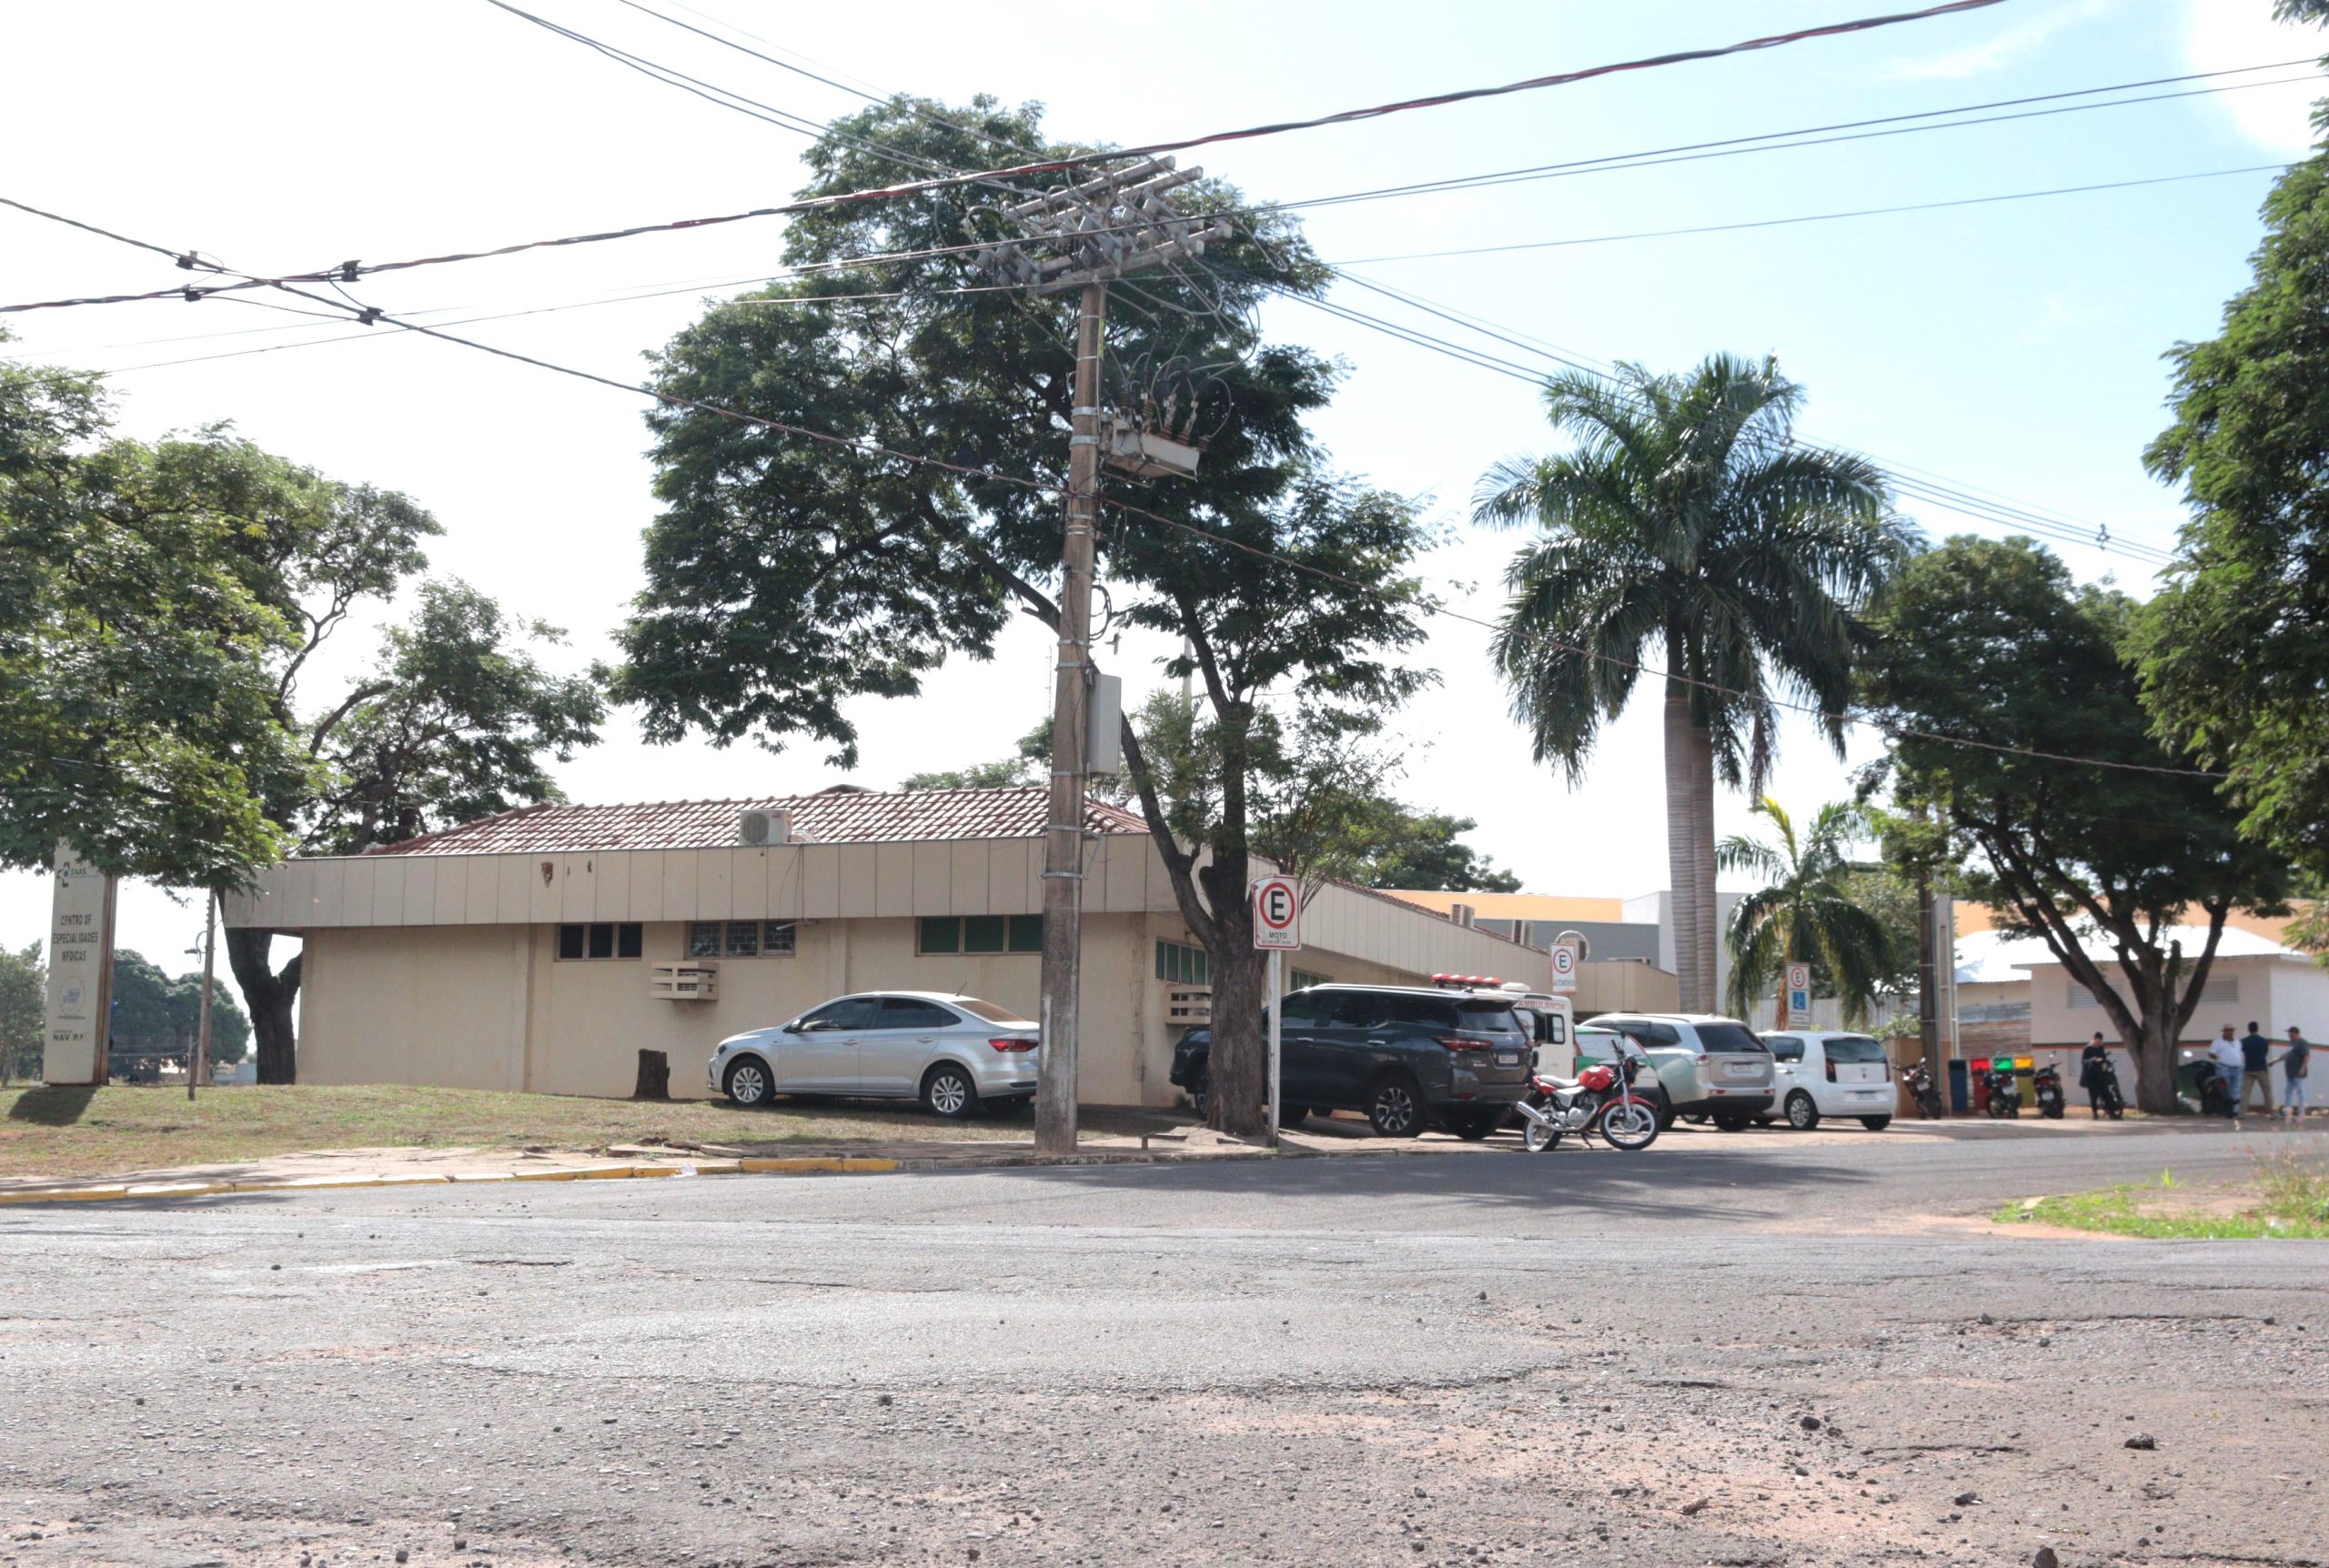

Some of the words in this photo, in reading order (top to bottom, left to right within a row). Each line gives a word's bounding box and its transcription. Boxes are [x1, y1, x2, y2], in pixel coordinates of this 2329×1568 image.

[1271, 890, 1285, 920] E
[52, 931, 99, 944] ESPECIALIDADES
[1559, 955, 1567, 968] E
